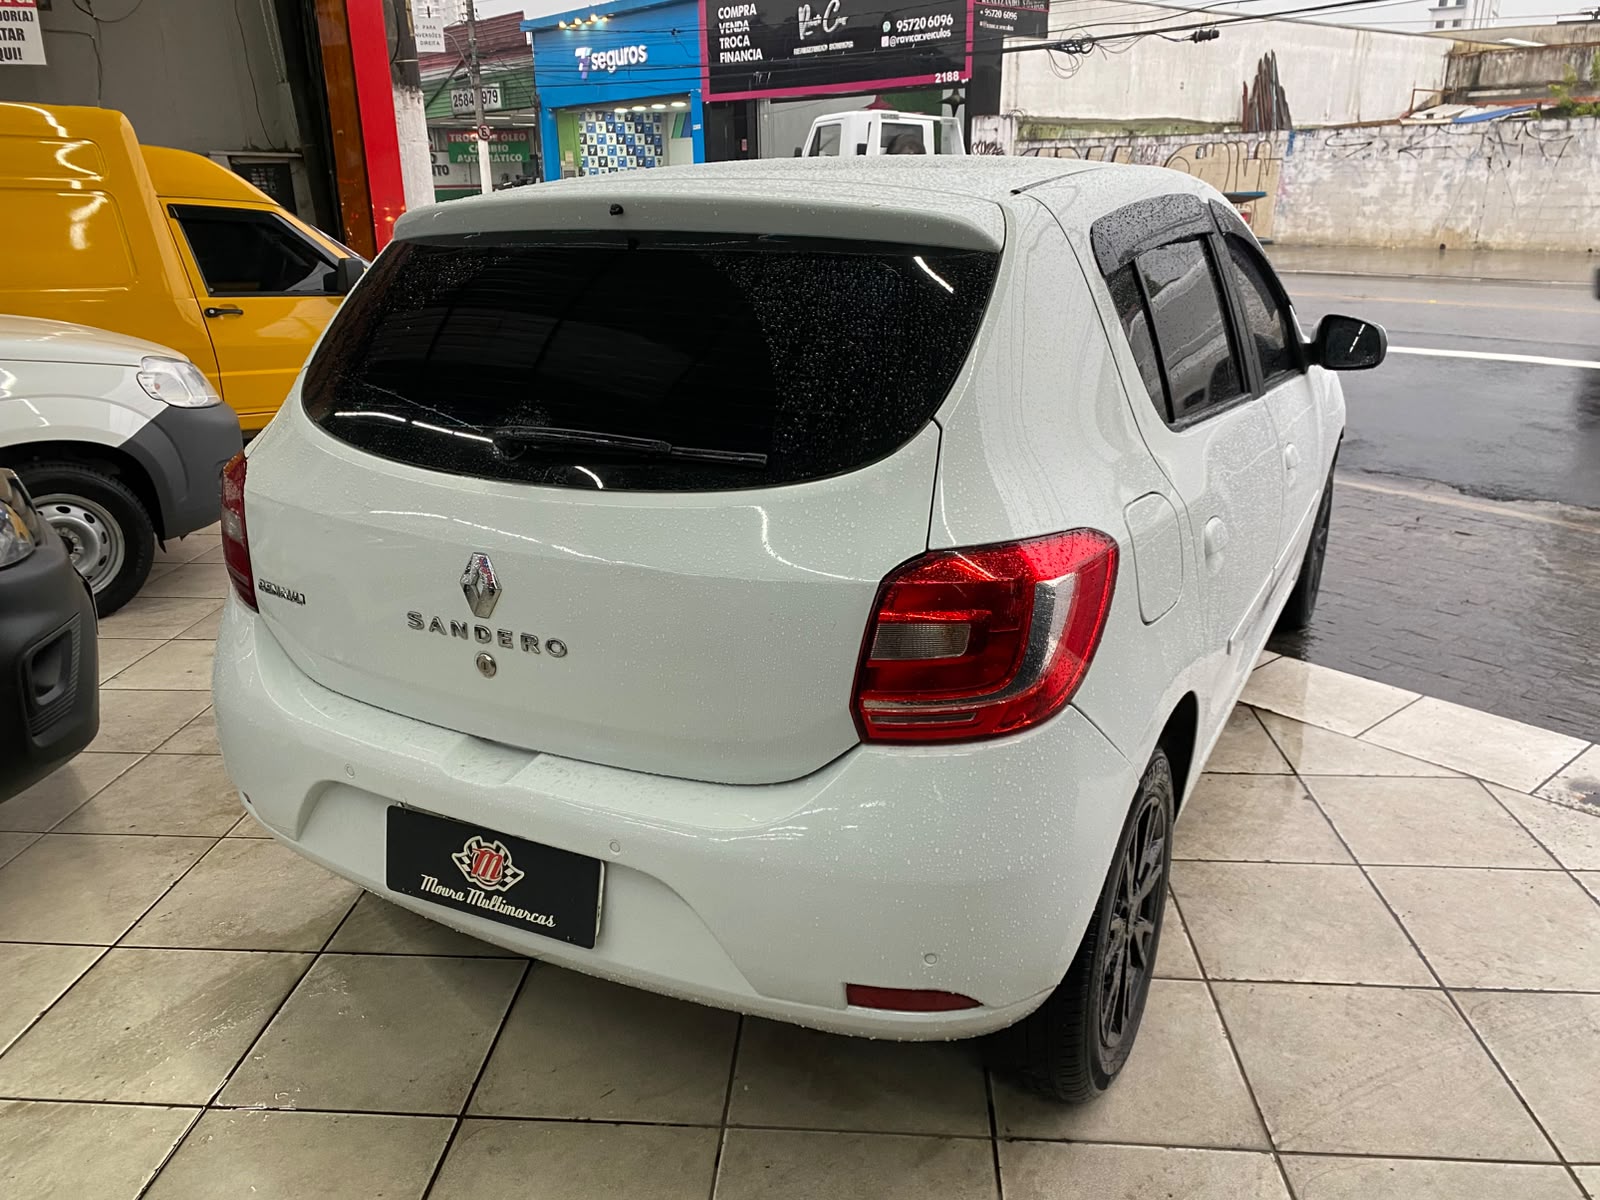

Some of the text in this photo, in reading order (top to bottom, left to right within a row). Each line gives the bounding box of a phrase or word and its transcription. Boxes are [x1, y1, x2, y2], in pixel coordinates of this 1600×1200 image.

[717, 3, 757, 20] COMPRA
[718, 19, 750, 35] VENDA
[896, 13, 954, 33] 95720 6096
[0, 27, 26, 41] TAR
[719, 34, 751, 50] TROCA
[719, 48, 764, 64] FINANCIA
[934, 71, 960, 84] 2188
[481, 89, 499, 104] 979
[406, 610, 569, 659] SANDERO
[420, 873, 466, 902] Moura
